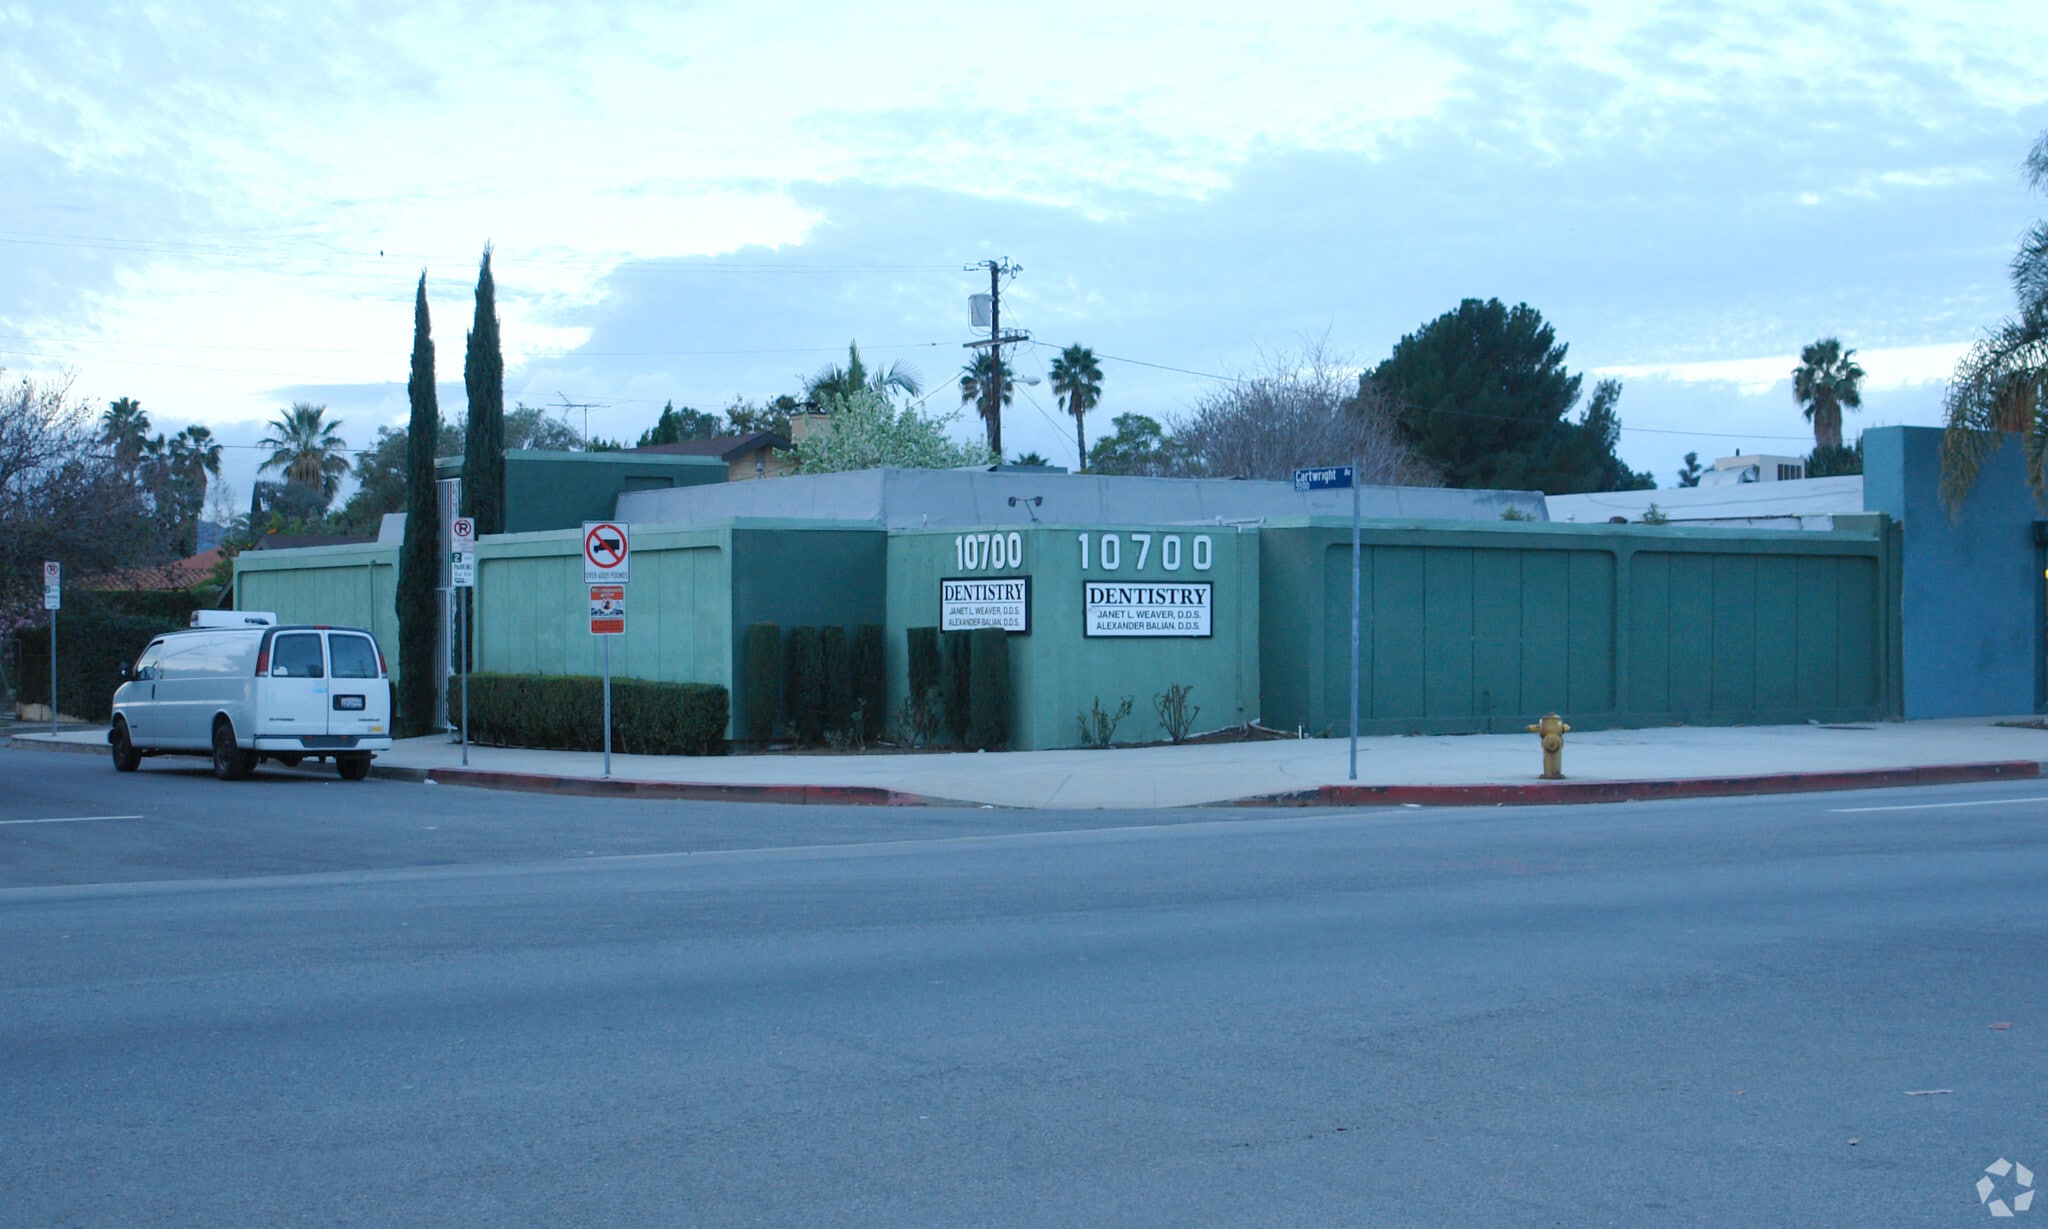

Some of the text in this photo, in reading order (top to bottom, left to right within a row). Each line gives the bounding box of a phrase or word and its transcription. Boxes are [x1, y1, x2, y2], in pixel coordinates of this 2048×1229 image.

[1296, 469, 1336, 484] Cartwright
[956, 532, 1022, 570] 10700
[1079, 533, 1212, 570] 10700
[945, 583, 1024, 601] DENTISTRY
[1089, 587, 1207, 605] DENTISTRY
[949, 607, 968, 616] JANET
[1097, 610, 1126, 619] JANET
[1136, 611, 1175, 620] WEAVER,
[1177, 611, 1202, 619] D.D.S.
[949, 618, 980, 627] ALEXANDER
[1096, 621, 1145, 630] ALEXANDER
[1178, 621, 1201, 630] D.D.S.
